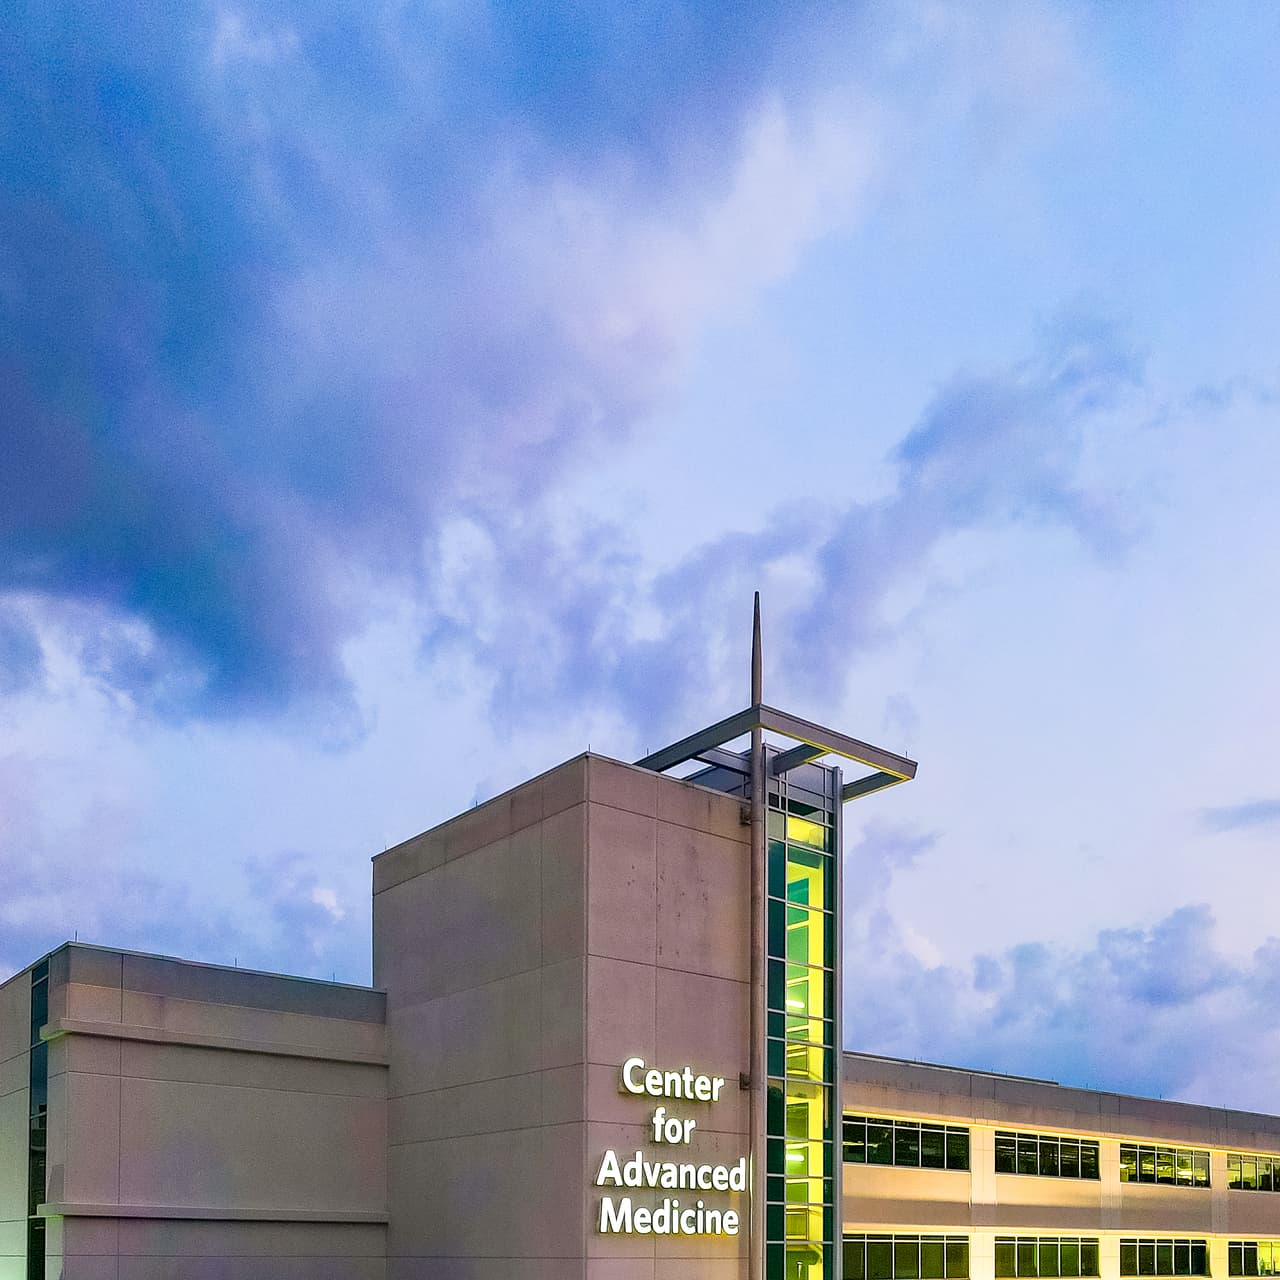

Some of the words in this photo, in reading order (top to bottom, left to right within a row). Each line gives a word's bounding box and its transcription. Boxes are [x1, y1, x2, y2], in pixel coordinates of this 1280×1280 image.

[623, 1057, 725, 1101] Center
[652, 1107, 696, 1144] for
[596, 1150, 746, 1191] Advanced
[600, 1197, 739, 1235] Medicine
